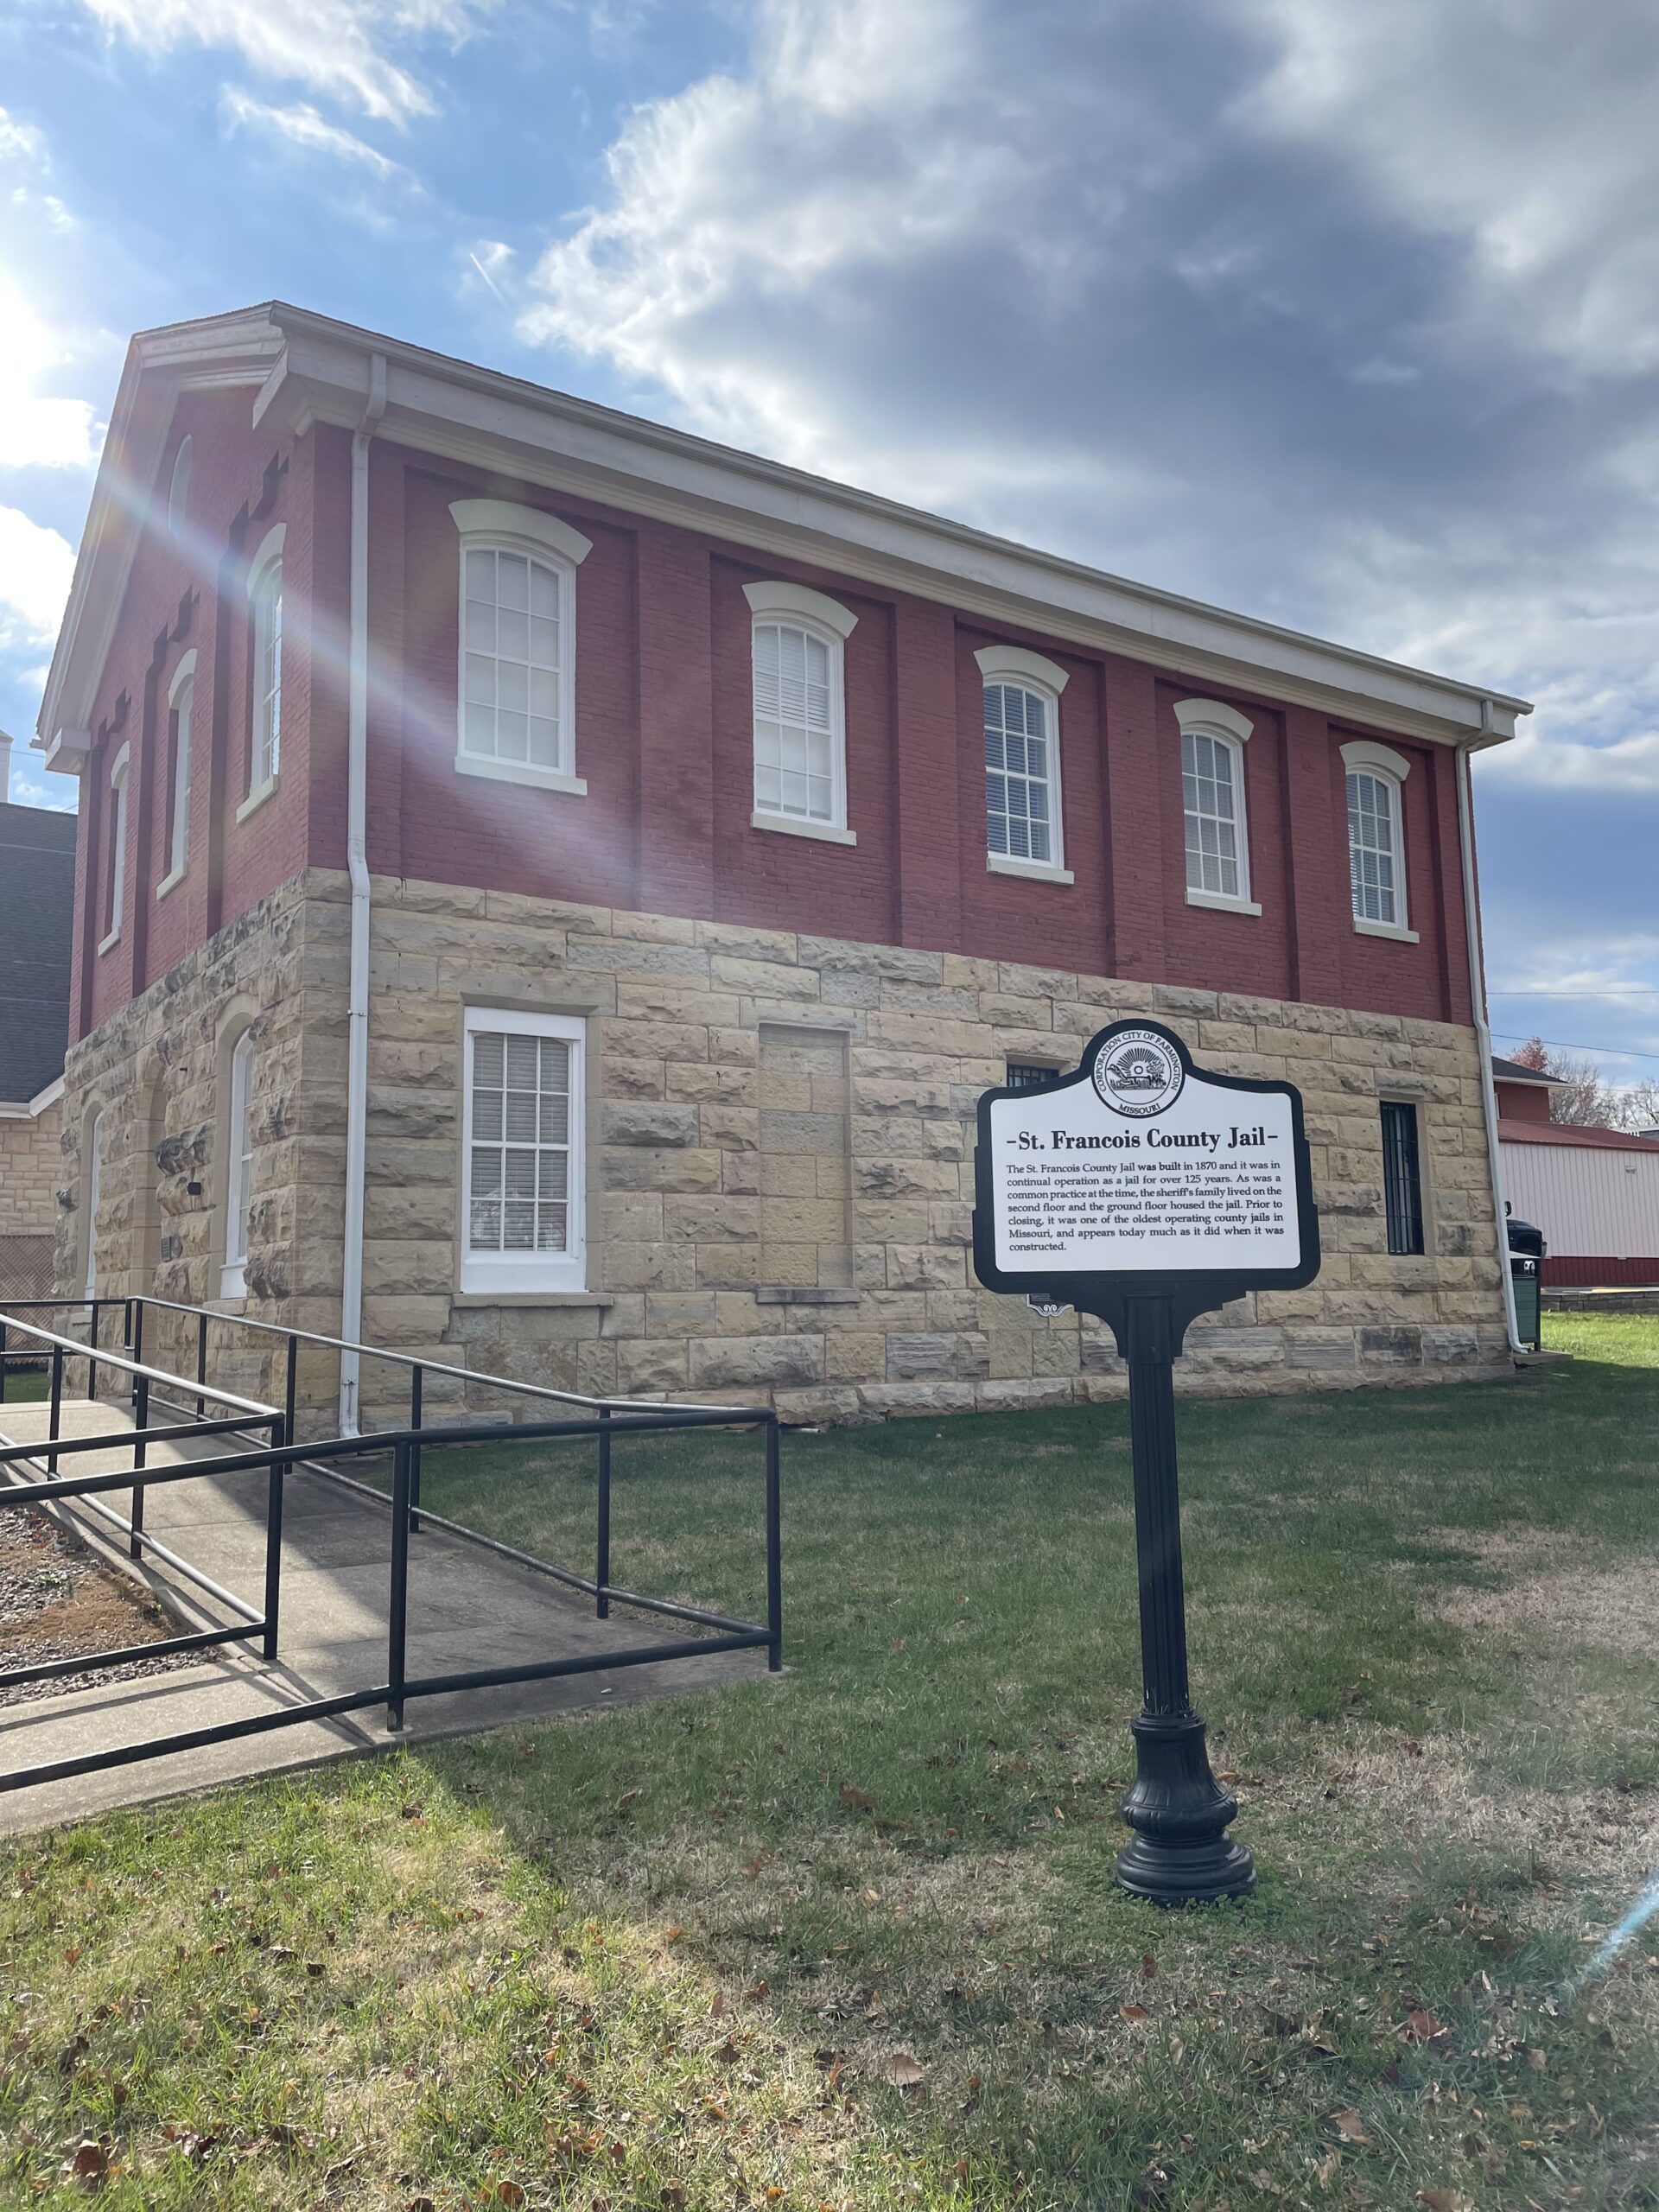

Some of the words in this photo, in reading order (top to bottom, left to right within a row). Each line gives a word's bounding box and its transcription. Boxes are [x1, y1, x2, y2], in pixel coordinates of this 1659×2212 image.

[1095, 1037, 1122, 1092] CORPORATION
[1122, 1031, 1142, 1041] CITY
[1143, 1032, 1156, 1041] OF
[1154, 1037, 1182, 1091] FARMINGTON
[1118, 1103, 1161, 1115] MISSOURI
[1051, 1128, 1141, 1150] Francois
[1147, 1128, 1221, 1153] County
[1007, 1164, 1024, 1174] The
[1027, 1164, 1038, 1173] St.
[1040, 1163, 1080, 1173] Francois
[1083, 1163, 1117, 1175] County
[1120, 1161, 1135, 1174] Jail
[1158, 1160, 1181, 1172] built
[1183, 1161, 1193, 1171] in
[1195, 1160, 1217, 1171] 1870
[1219, 1160, 1237, 1170] and
[1240, 1160, 1247, 1170] it
[1271, 1160, 1281, 1169] in
[1007, 1176, 1051, 1187] continual
[1054, 1176, 1099, 1189] operation
[1125, 1175, 1139, 1187] jail
[1143, 1174, 1157, 1185] for
[1185, 1173, 1201, 1184] 125
[1205, 1176, 1232, 1186] years.
[1236, 1173, 1249, 1183] As
[1050, 1189, 1087, 1202] practice
[1088, 1190, 1097, 1198] at
[1099, 1188, 1114, 1198] the
[1115, 1188, 1139, 1198] time,
[1140, 1187, 1155, 1198] the
[1195, 1186, 1225, 1199] family
[1227, 1185, 1251, 1197] lived
[1267, 1185, 1281, 1196] the
[1008, 1202, 1040, 1212] second
[1043, 1202, 1065, 1212] floor
[1069, 1201, 1086, 1211] and
[1090, 1201, 1104, 1211] the
[1107, 1201, 1141, 1214] ground
[1145, 1200, 1167, 1211] floor
[1170, 1199, 1205, 1210] housed
[1208, 1199, 1224, 1210] the
[1226, 1199, 1243, 1212] jail.
[1245, 1199, 1270, 1209] Prior
[1273, 1199, 1282, 1209] to
[1008, 1216, 1044, 1228] closing,
[1048, 1215, 1054, 1225] it
[1101, 1214, 1110, 1224] of
[1114, 1214, 1129, 1224] the
[1133, 1213, 1161, 1224] oldest
[1165, 1213, 1211, 1226] operating
[1214, 1213, 1248, 1225] county
[1251, 1211, 1270, 1225] jails
[1274, 1211, 1283, 1222] in
[1009, 1229, 1052, 1239] Missouri,
[1057, 1228, 1074, 1238] and
[1078, 1230, 1116, 1240] appears
[1119, 1227, 1146, 1239] today
[1149, 1226, 1177, 1236] much
[1194, 1226, 1201, 1236] it
[1205, 1225, 1220, 1236] did
[1224, 1225, 1251, 1236] when
[1255, 1225, 1262, 1236] it
[1009, 1241, 1066, 1251] constructed.
